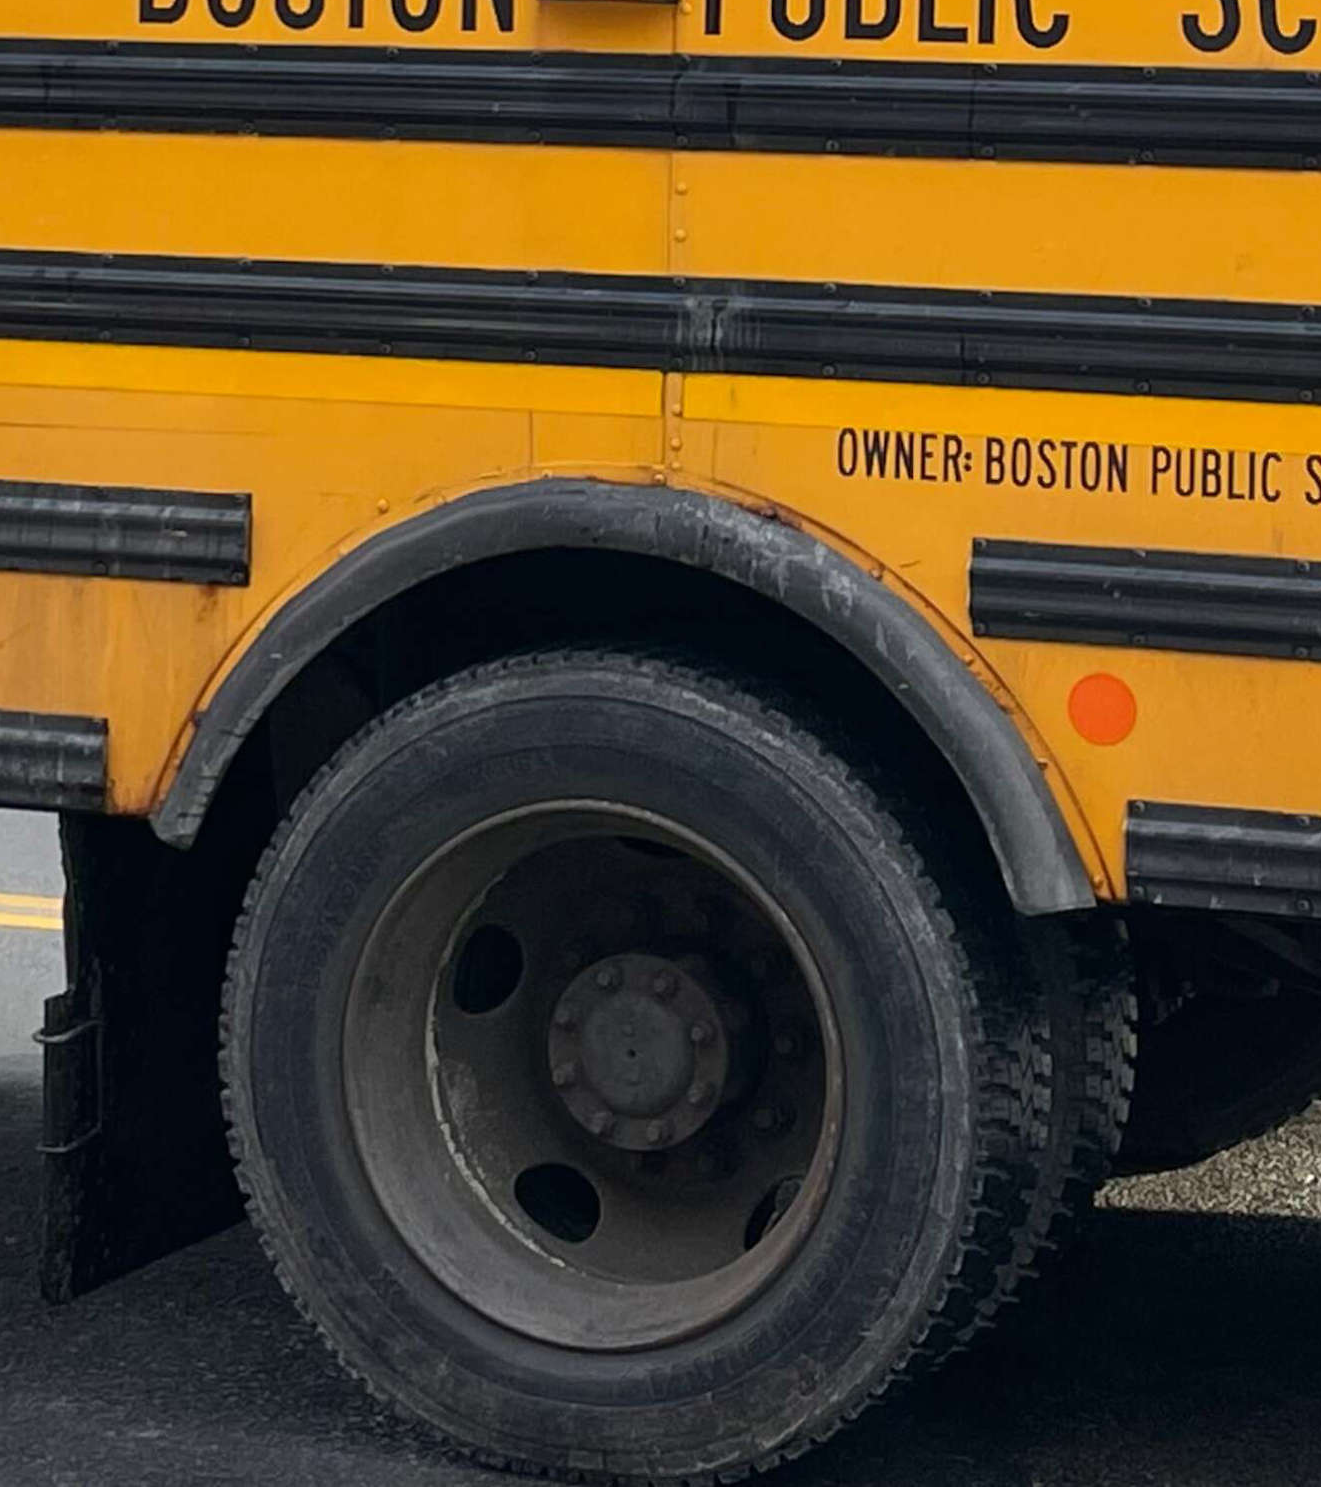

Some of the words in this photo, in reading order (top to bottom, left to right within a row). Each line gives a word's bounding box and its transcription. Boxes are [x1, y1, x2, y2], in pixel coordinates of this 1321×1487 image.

[837, 427, 972, 482] OWNER:
[986, 437, 1129, 493] BOSTON
[1152, 446, 1282, 503] PUBLIC
